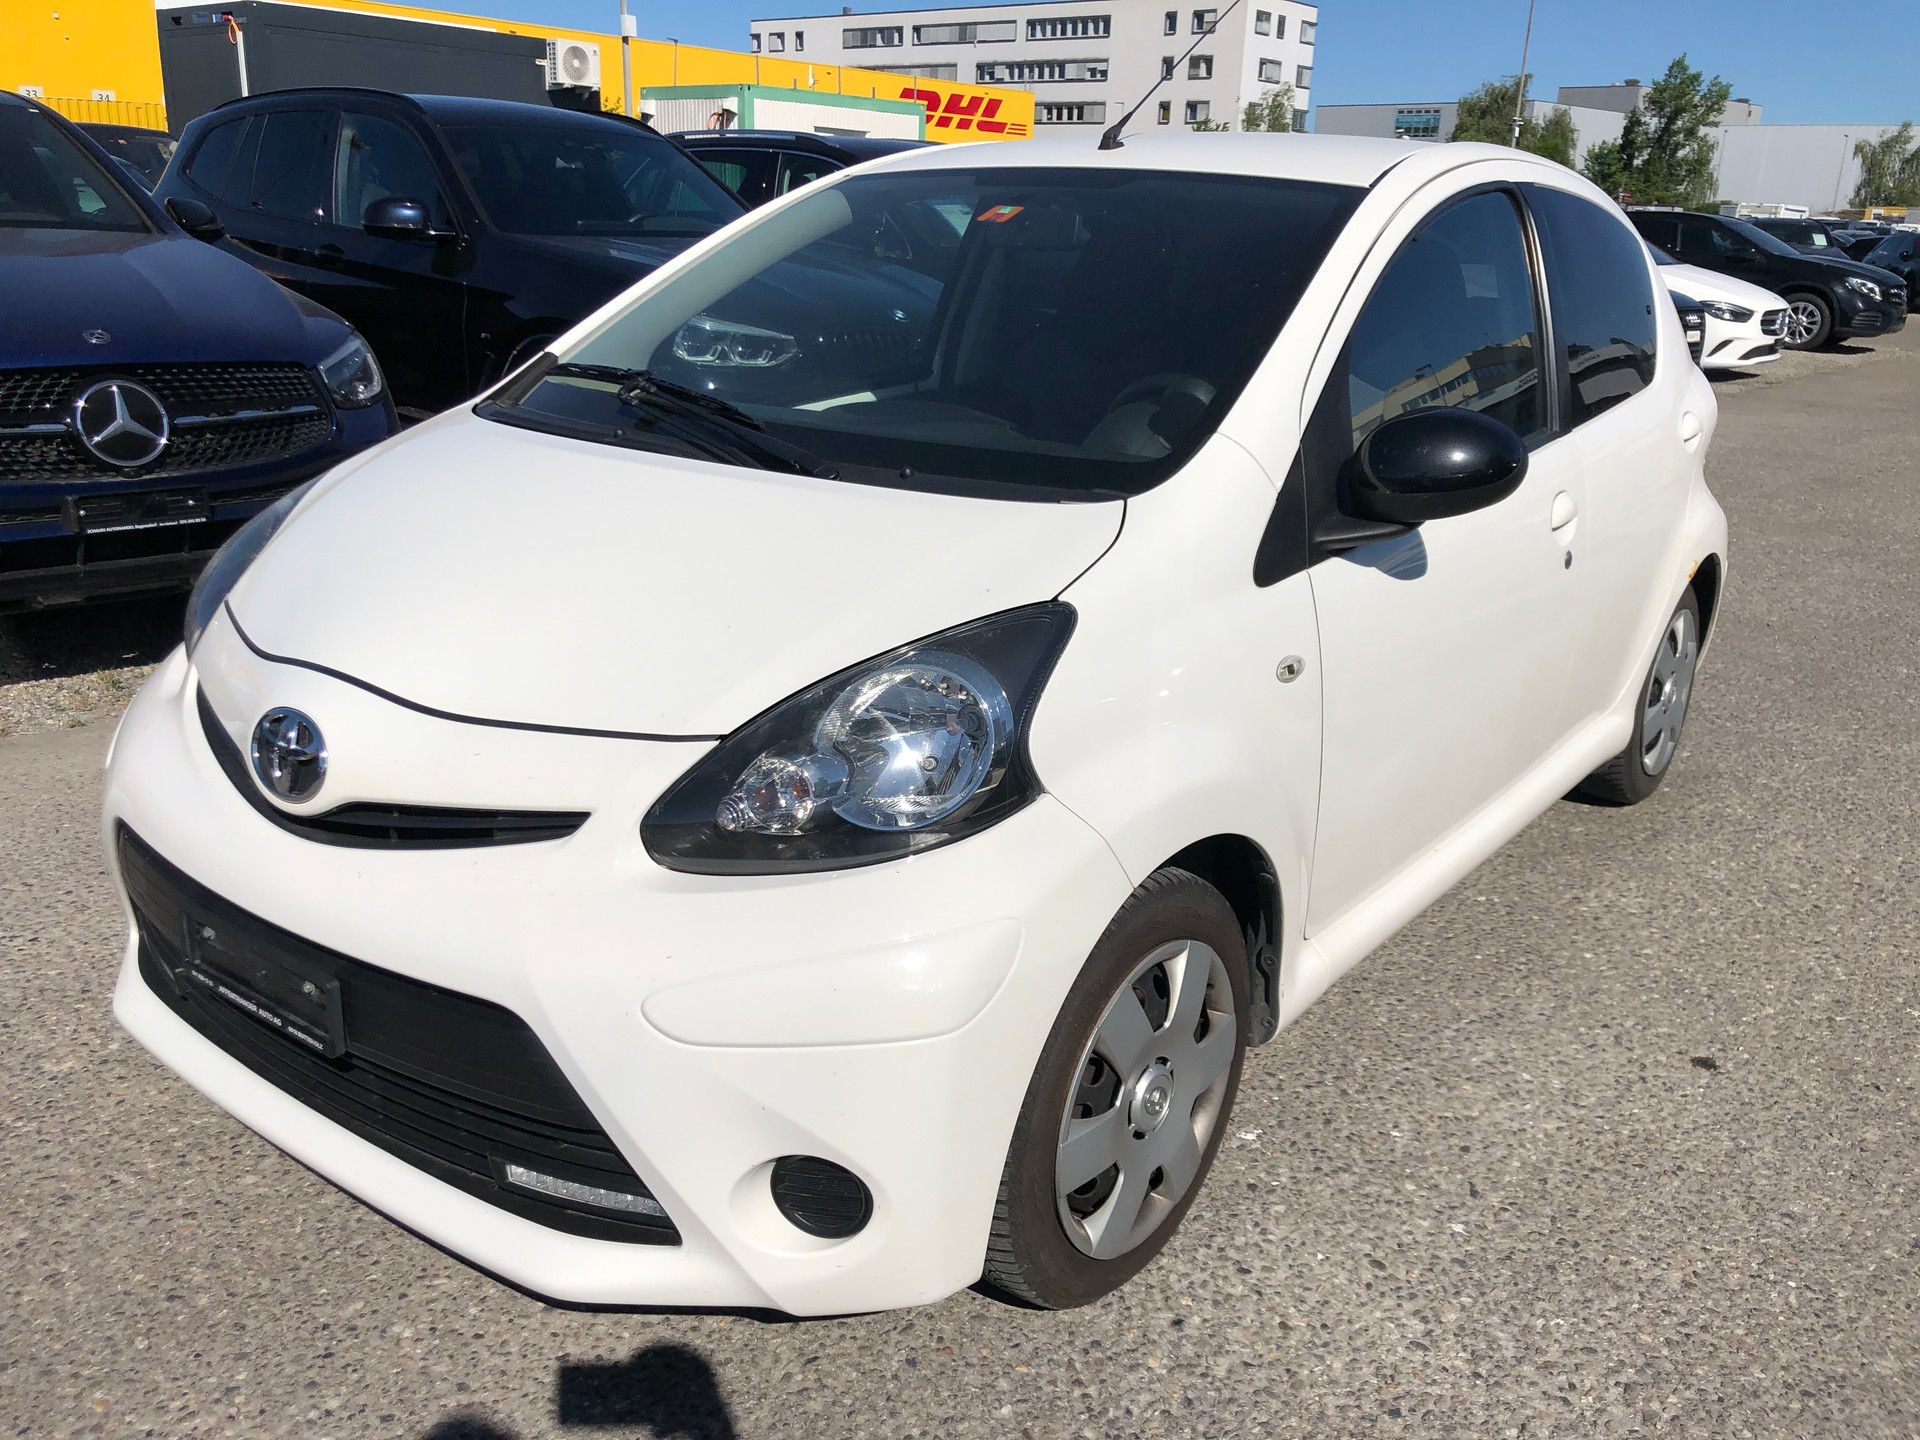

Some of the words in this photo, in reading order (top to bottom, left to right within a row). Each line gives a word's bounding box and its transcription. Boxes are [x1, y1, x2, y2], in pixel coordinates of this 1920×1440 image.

[899, 87, 1008, 134] DHL
[258, 1008, 274, 1022] AUTO
[273, 1016, 282, 1026] AG
